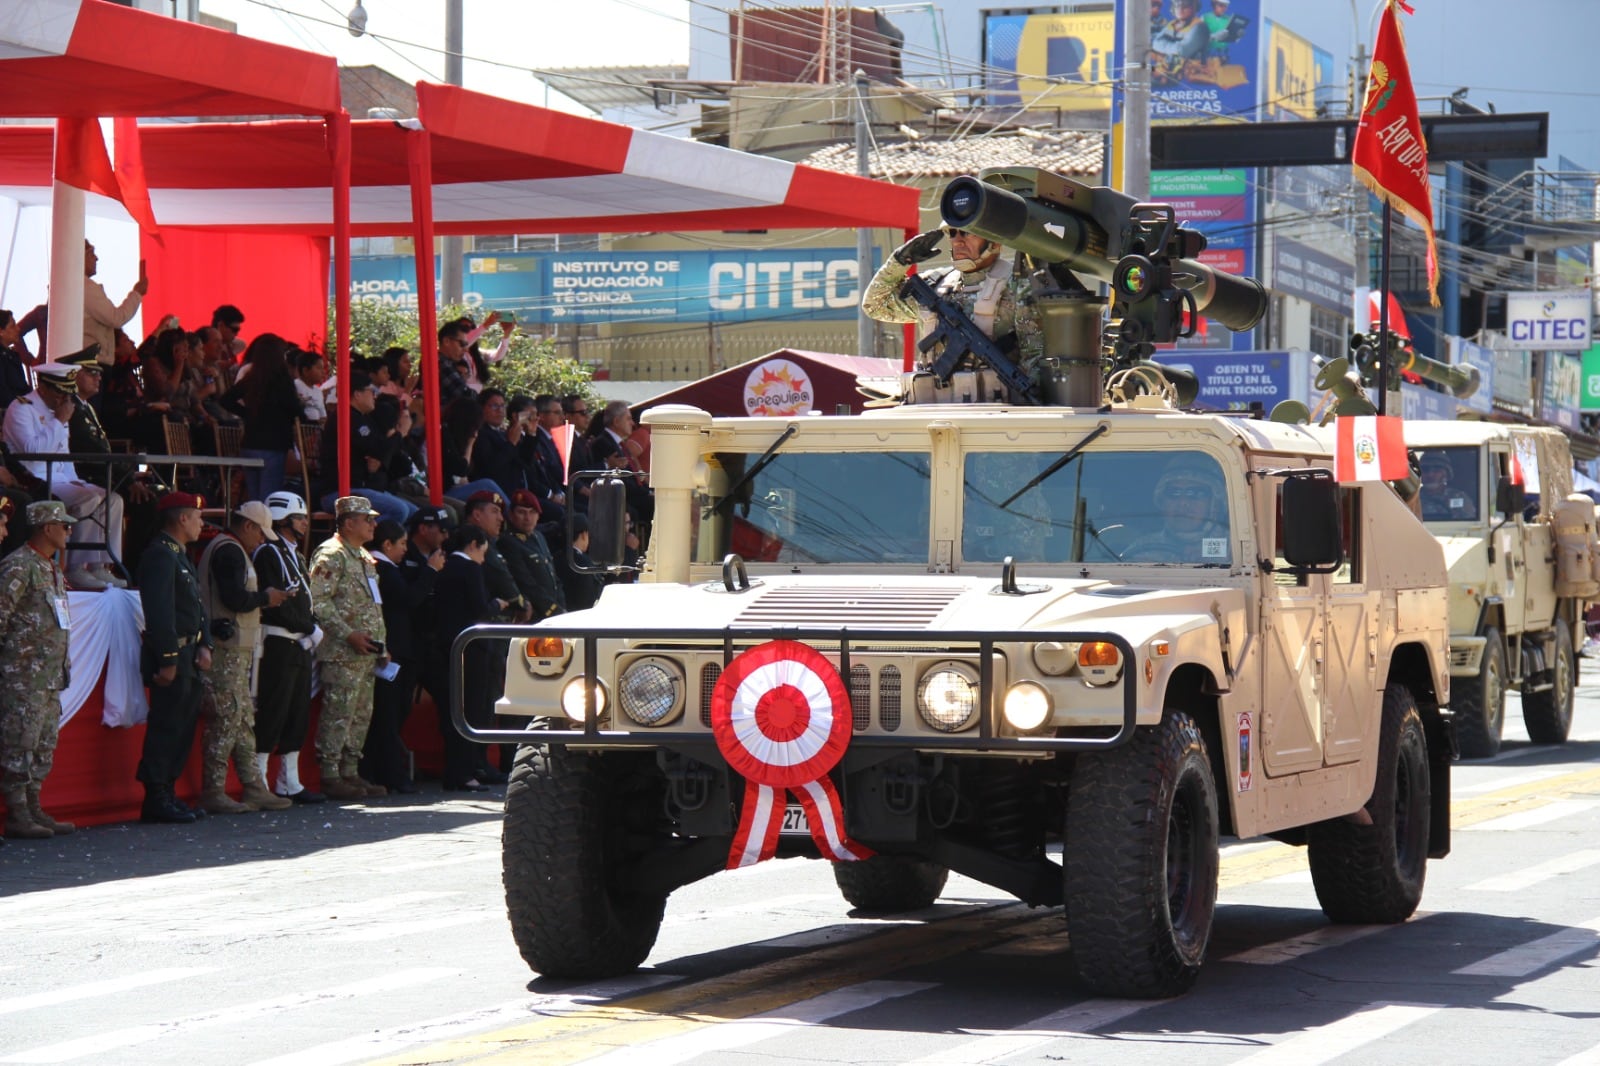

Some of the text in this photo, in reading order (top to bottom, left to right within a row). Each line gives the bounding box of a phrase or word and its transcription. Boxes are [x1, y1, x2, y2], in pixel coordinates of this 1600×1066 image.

[1046, 21, 1113, 33] INSTITUTO
[1152, 89, 1218, 100] CARRERAS
[1152, 183, 1209, 192] E INDUSTRIAL
[552, 261, 680, 273] INSTITUTO DE
[552, 272, 664, 288] EDUCACIÓN
[709, 259, 860, 310] CITEC
[349, 280, 410, 293] HORA
[552, 289, 633, 303] TÉCNICA
[1512, 319, 1586, 340] CITEC
[1252, 364, 1265, 374] TU
[1245, 375, 1259, 384] EN
[1262, 374, 1272, 384] EL
[1202, 386, 1232, 396] NIVEL
